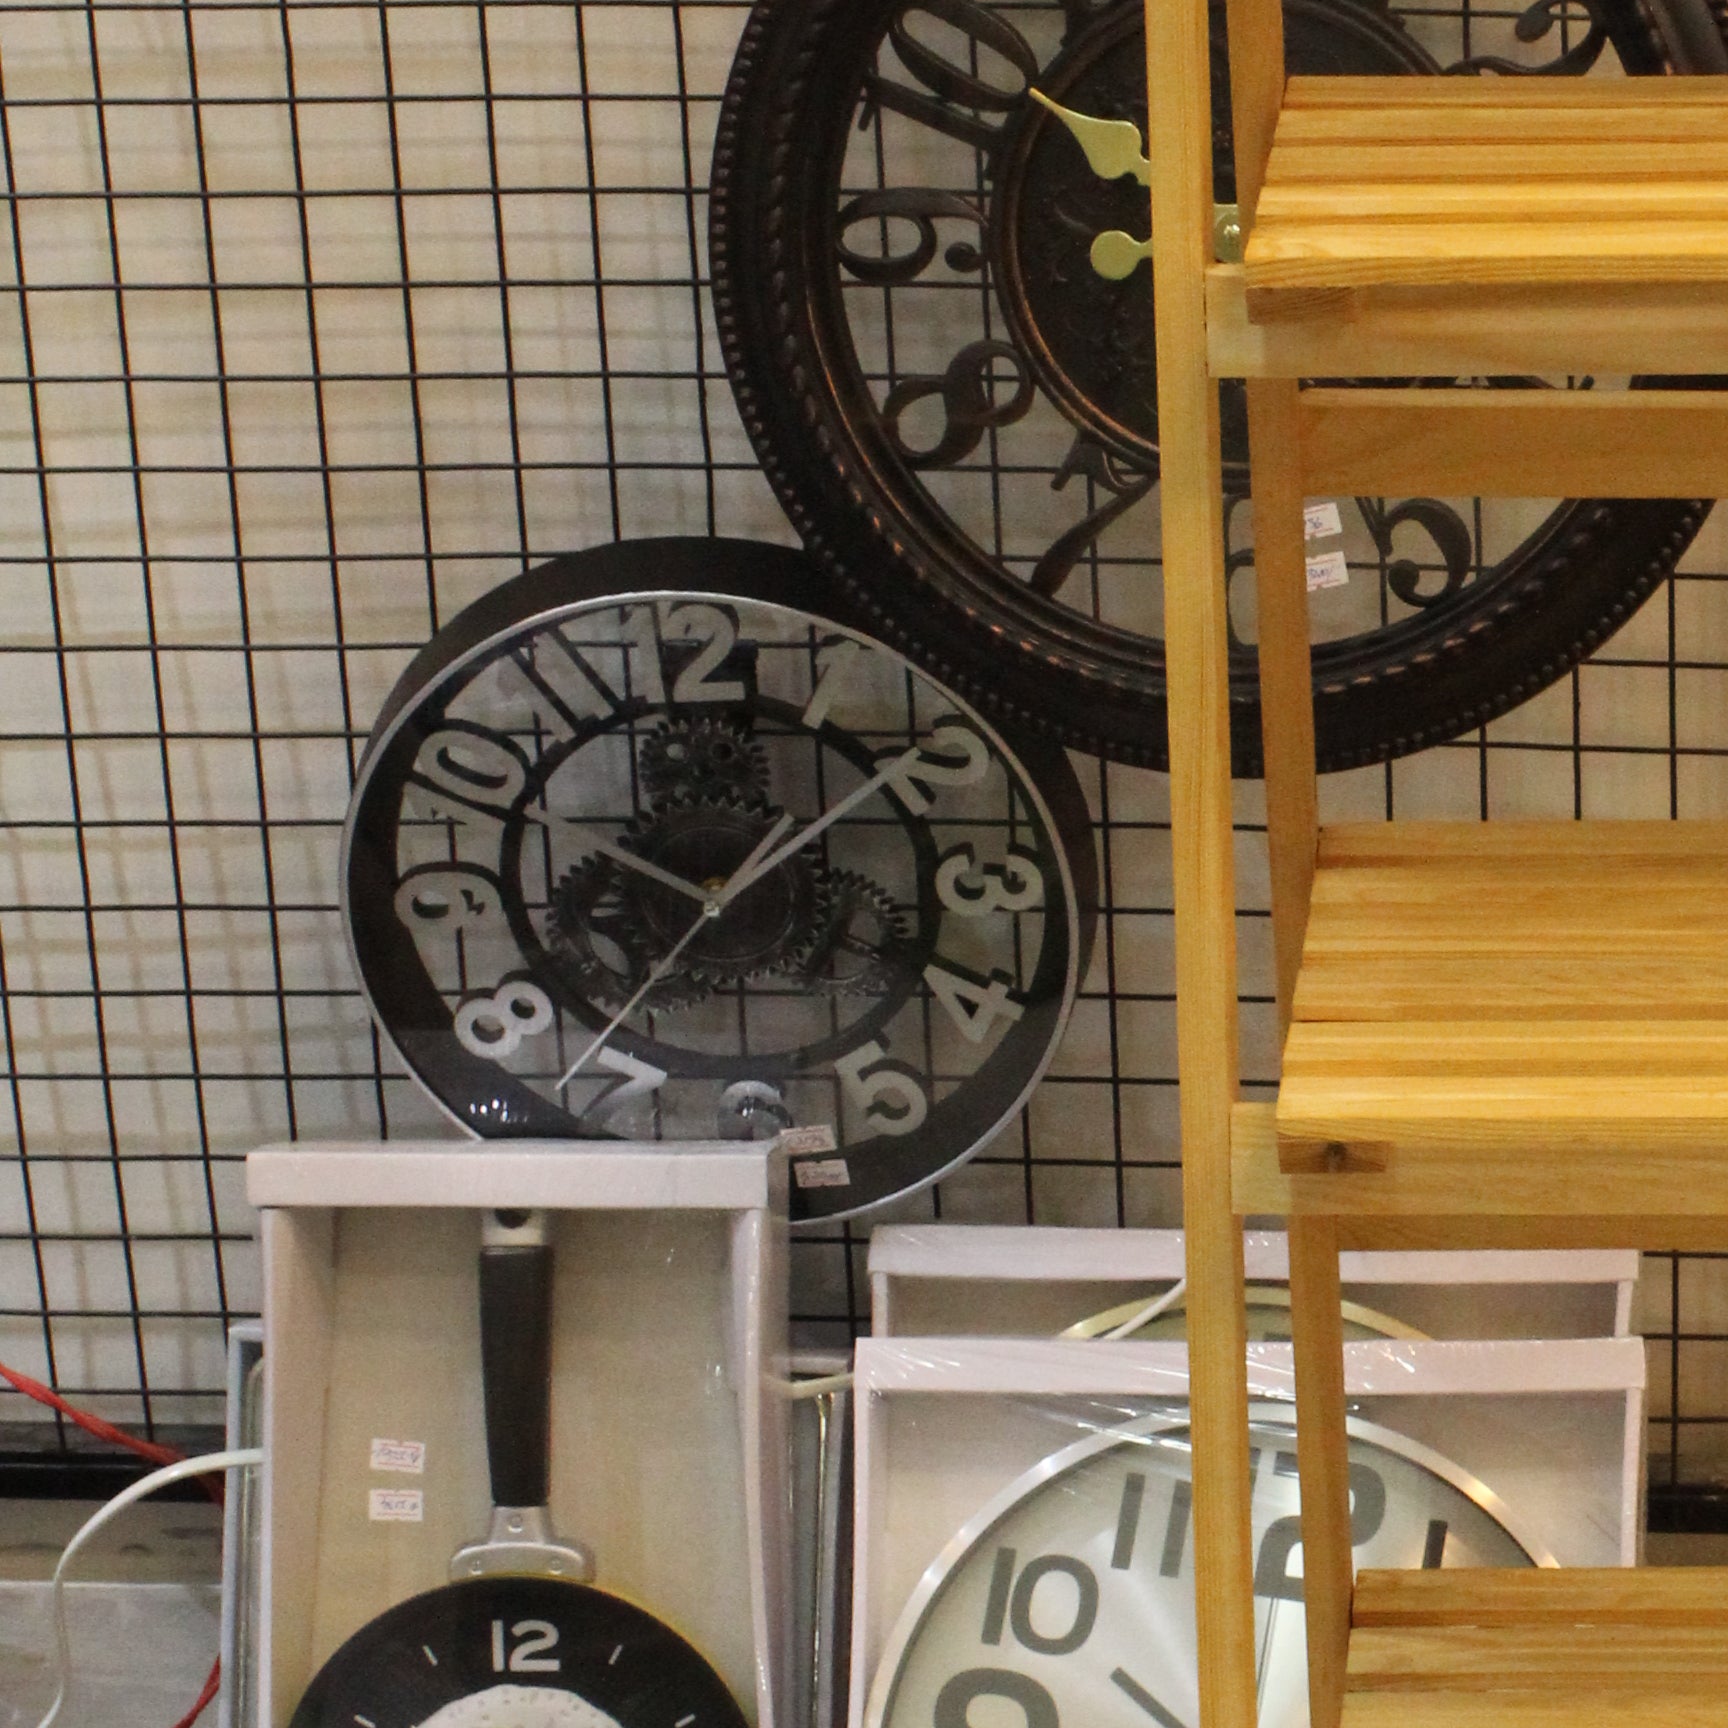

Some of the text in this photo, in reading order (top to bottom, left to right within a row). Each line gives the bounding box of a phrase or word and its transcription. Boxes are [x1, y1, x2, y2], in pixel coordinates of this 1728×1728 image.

[836, 186, 991, 283] 9
[882, 338, 1036, 470] 8
[620, 601, 746, 704] 12
[872, 726, 991, 817] 2
[934, 853, 1045, 917] 3
[453, 980, 554, 1060] 8
[922, 962, 1027, 1045] 4
[834, 1039, 929, 1137] 5
[1111, 1472, 1193, 1578] 11
[491, 1618, 561, 1673] 12
[980, 1546, 1099, 1657] 10
